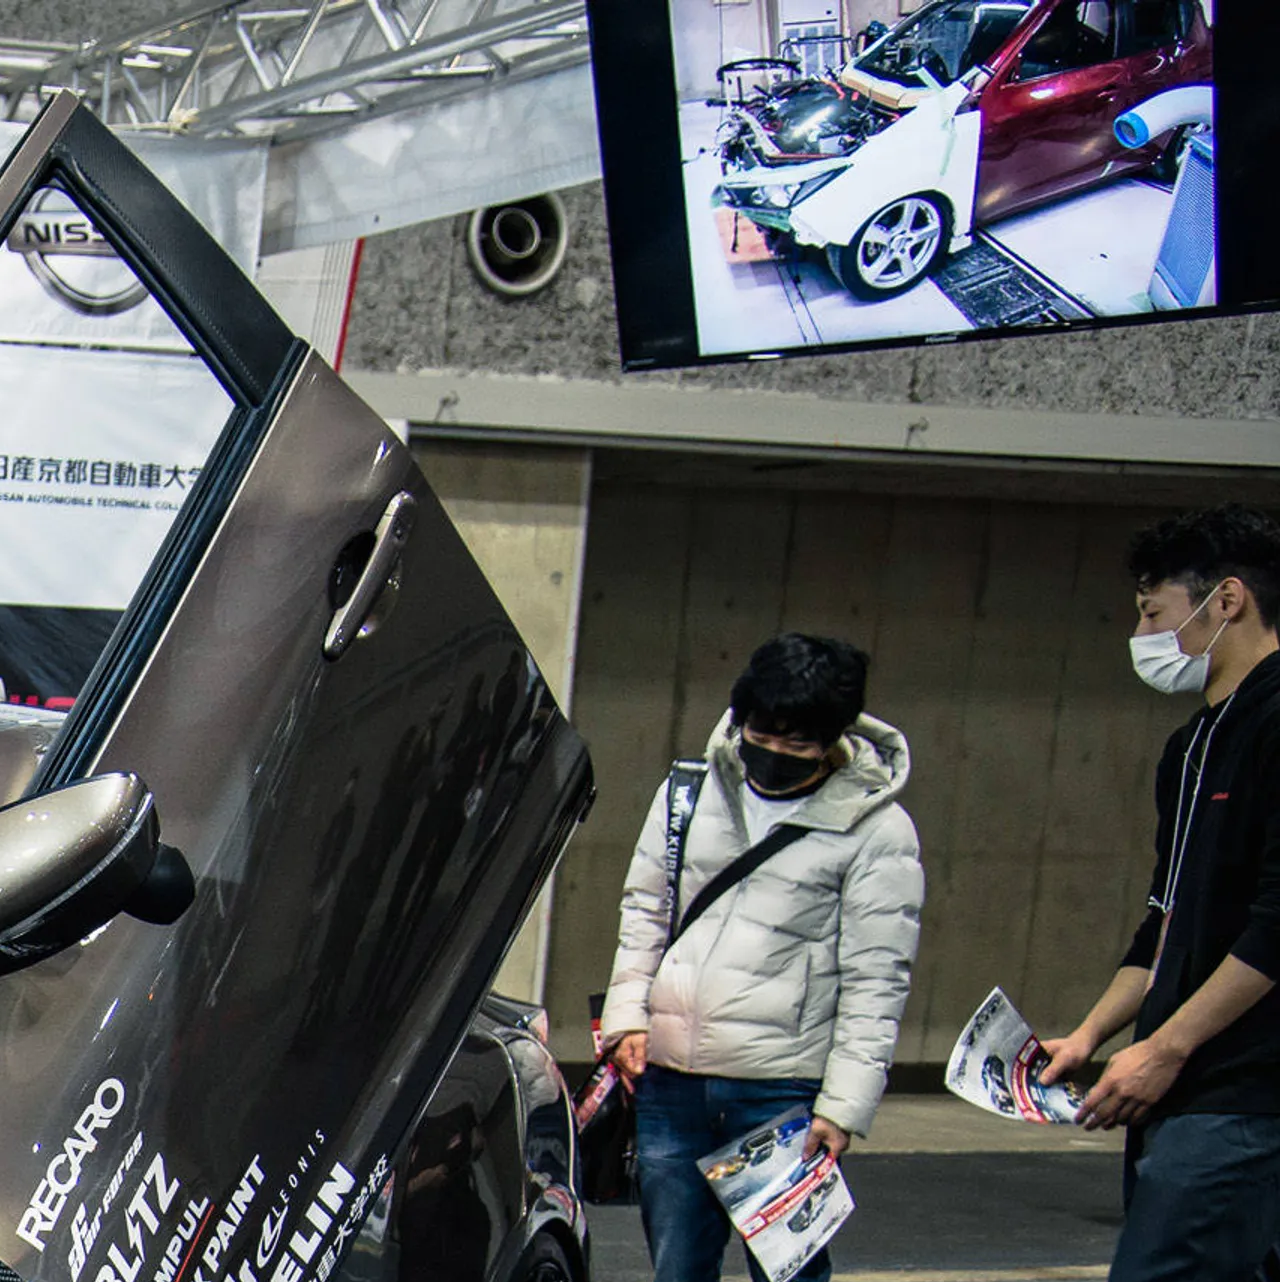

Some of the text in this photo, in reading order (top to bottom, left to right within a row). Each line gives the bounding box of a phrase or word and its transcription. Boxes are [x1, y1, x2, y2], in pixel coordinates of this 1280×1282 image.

[27, 493, 93, 508] AUTOMOBILE
[97, 497, 152, 510] TECHNICAL
[16, 1077, 125, 1252] RECARO
[202, 1153, 266, 1274] PAINT
[273, 1128, 327, 1219] LEONIS
